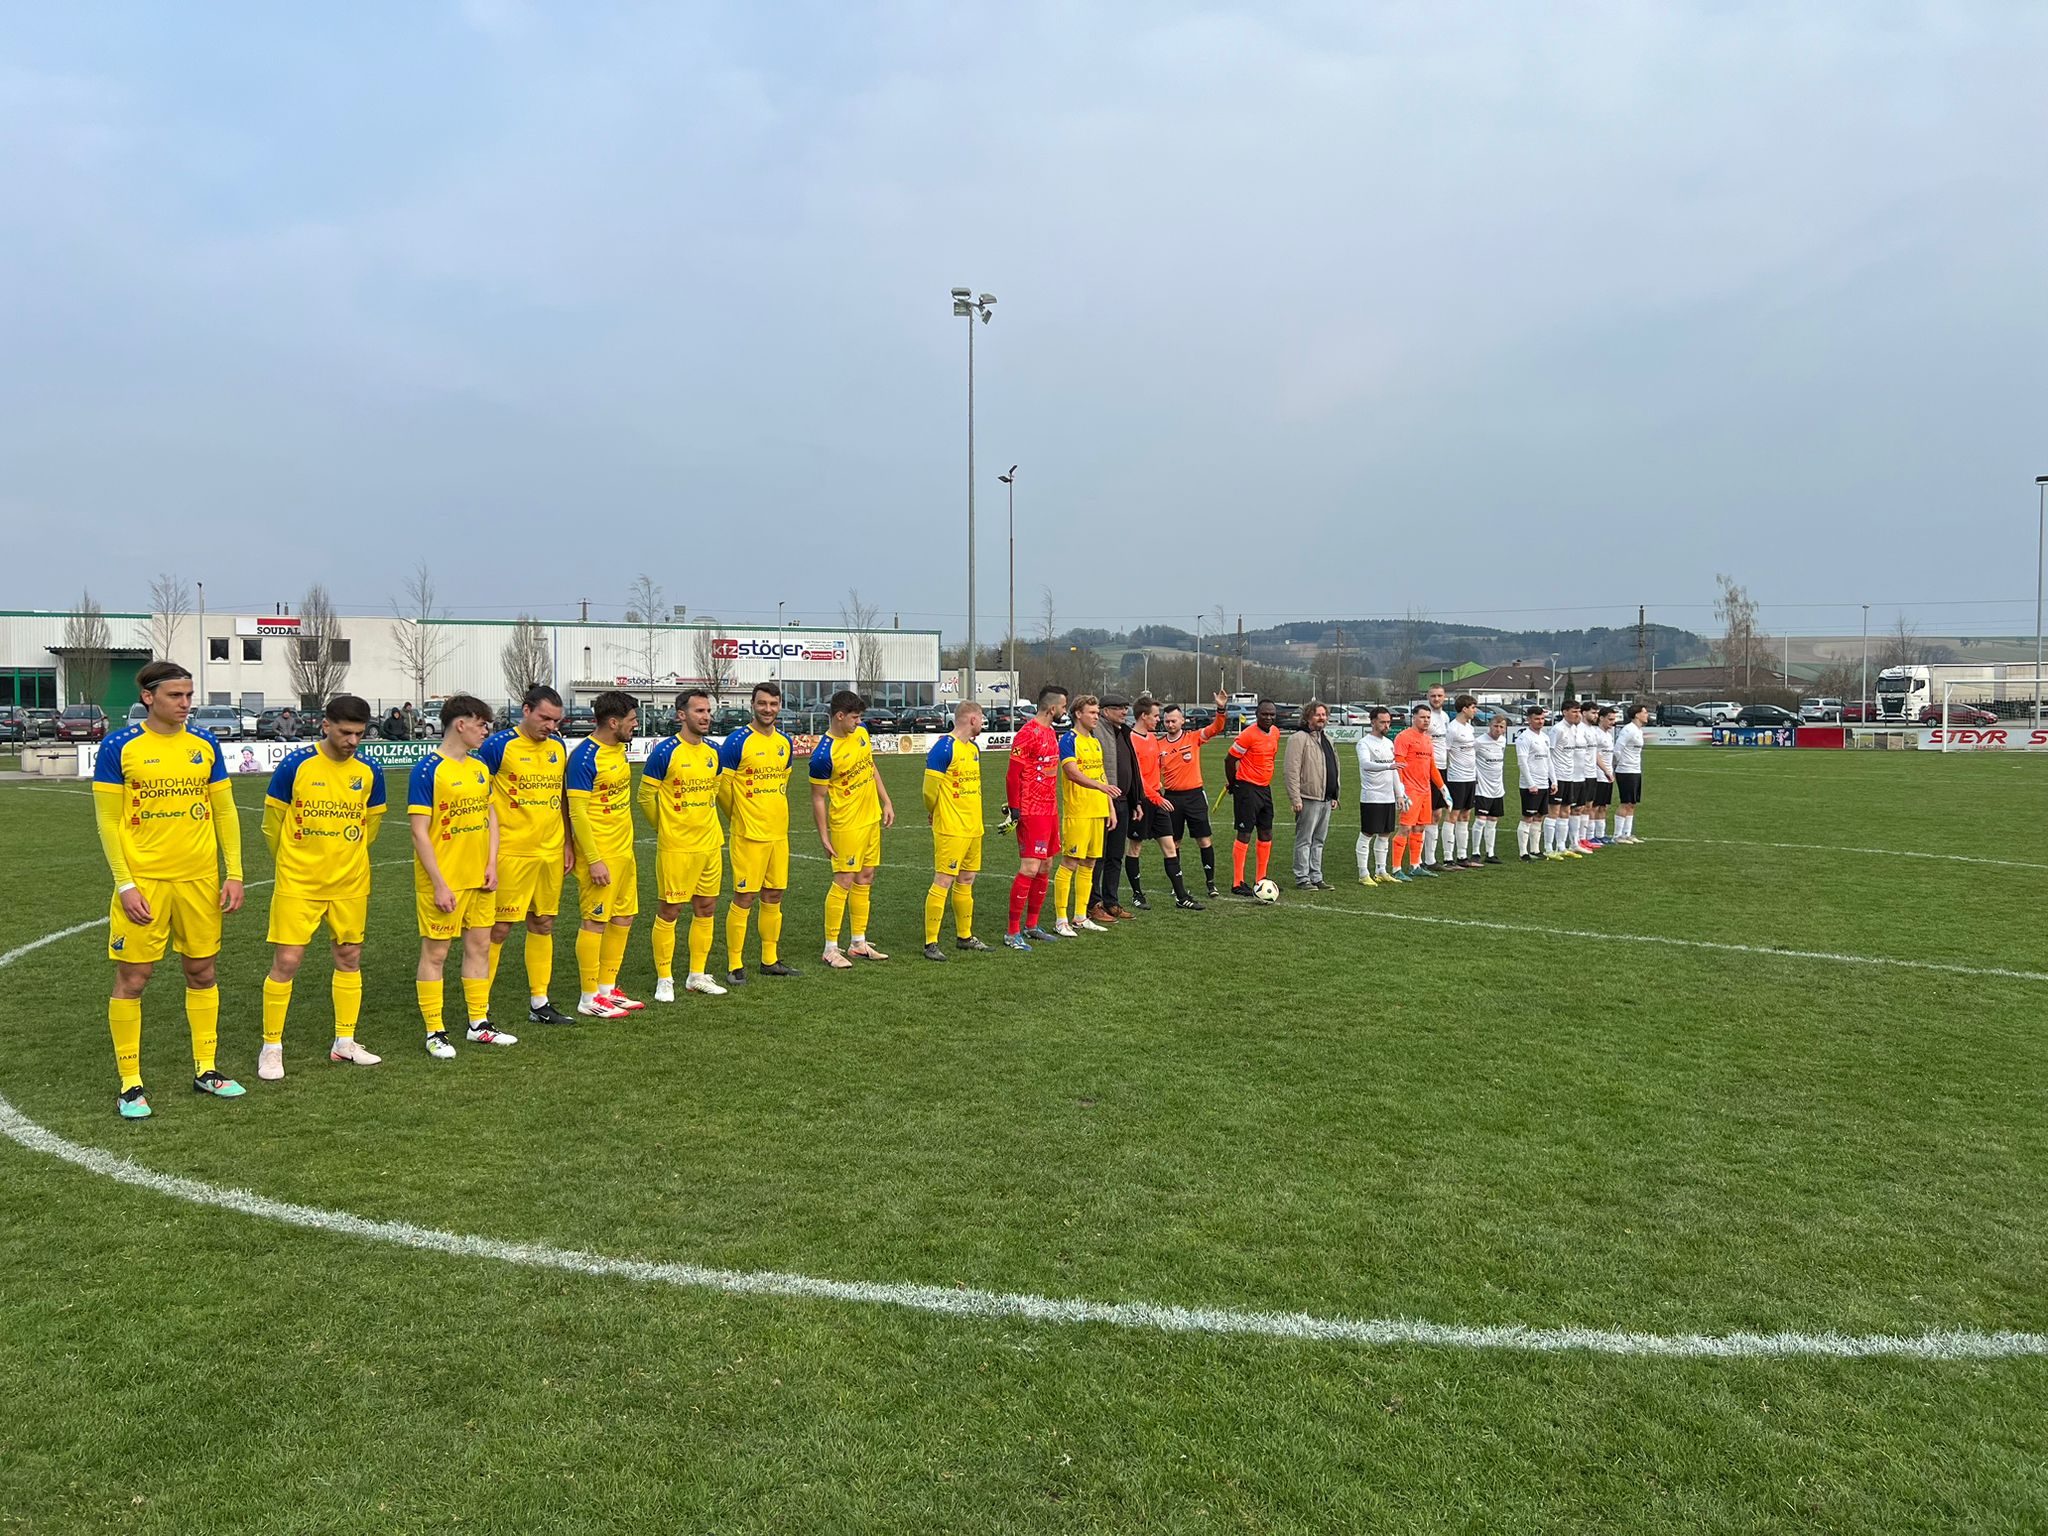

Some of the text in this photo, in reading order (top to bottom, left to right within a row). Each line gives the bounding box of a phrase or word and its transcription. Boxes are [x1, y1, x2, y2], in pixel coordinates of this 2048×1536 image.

[257, 626, 300, 635] SOUDAL
[739, 639, 803, 659] stöger
[988, 736, 1011, 744] CASE
[1928, 729, 2008, 744] STEYR
[364, 744, 437, 757] HOLZFACHM
[382, 756, 413, 764] Valentin
[141, 777, 207, 790] AUTOHAUS
[140, 788, 204, 799] DORFMAYER
[304, 800, 364, 811] AUTOHAUS
[303, 809, 362, 820] DORFMAYER
[119, 1053, 138, 1061] JAKO
